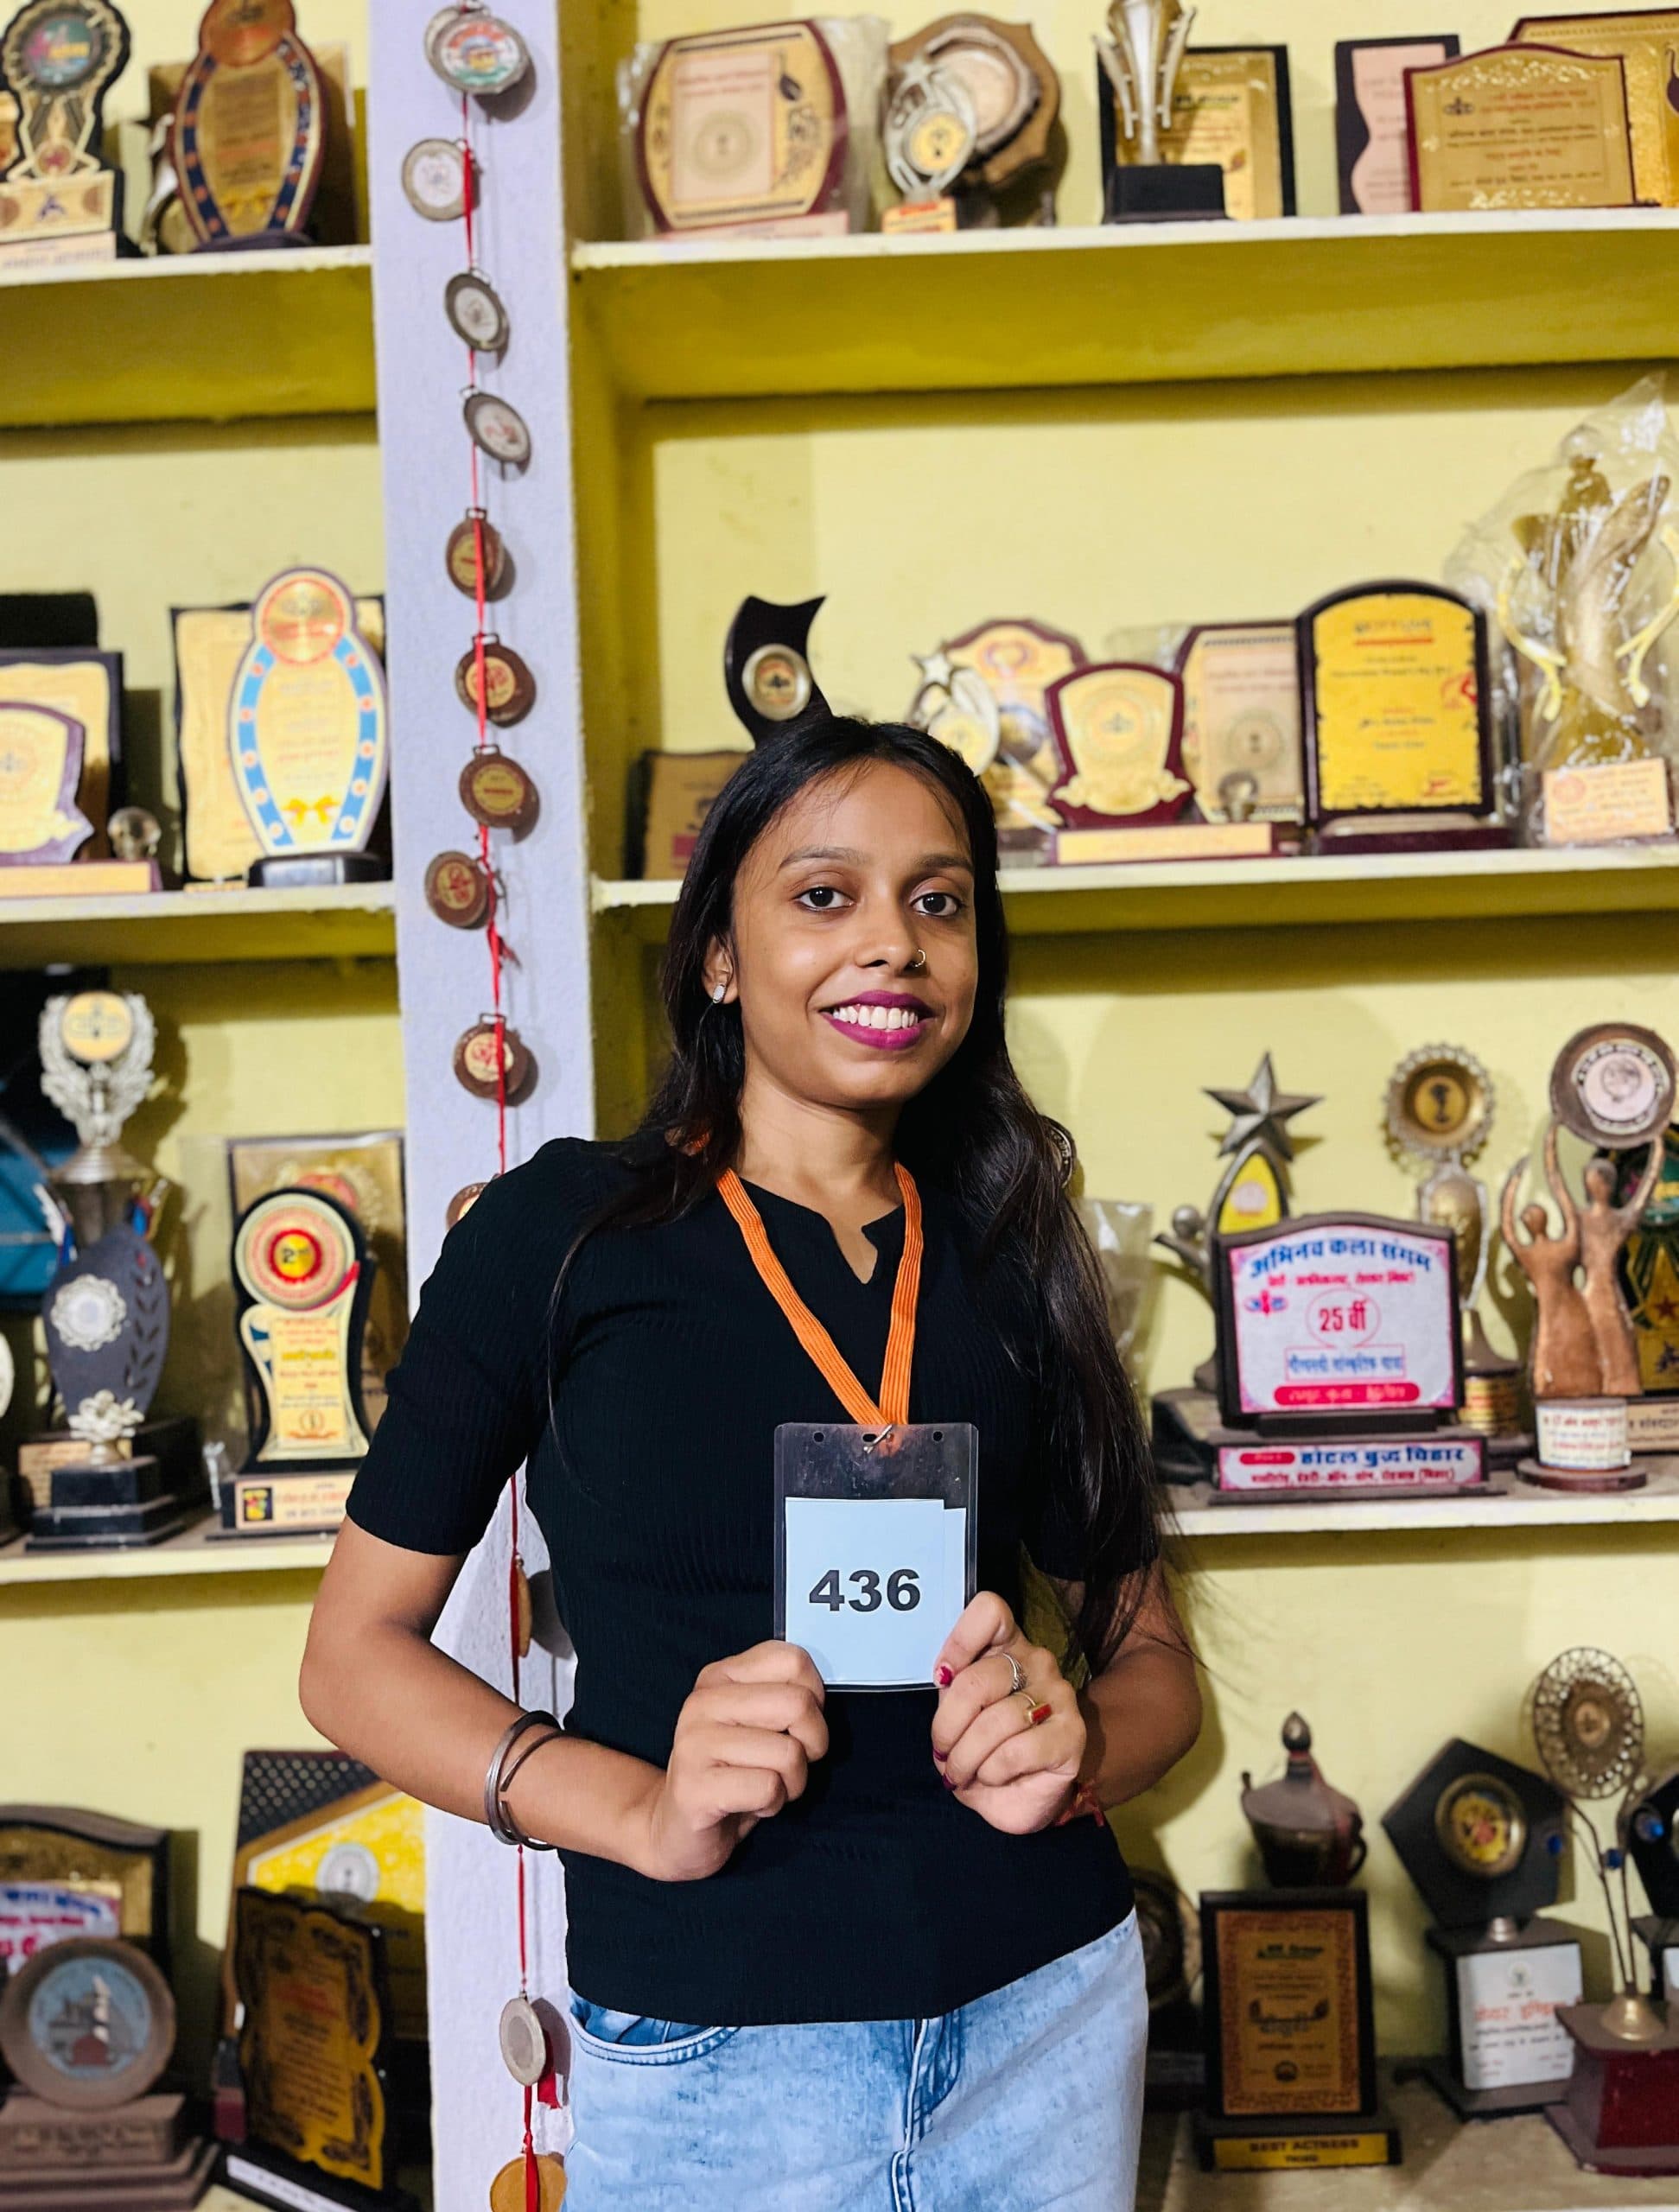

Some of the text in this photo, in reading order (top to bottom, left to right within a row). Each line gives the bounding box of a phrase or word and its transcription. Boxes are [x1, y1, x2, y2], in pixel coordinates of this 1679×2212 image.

[1251, 1238, 1432, 1277] अभिनव कला संगम
[1319, 1306, 1344, 1332] 25
[1301, 1446, 1358, 1465] होटल
[809, 1568, 921, 1613] 436
[1249, 2140, 1288, 2153] BEST
